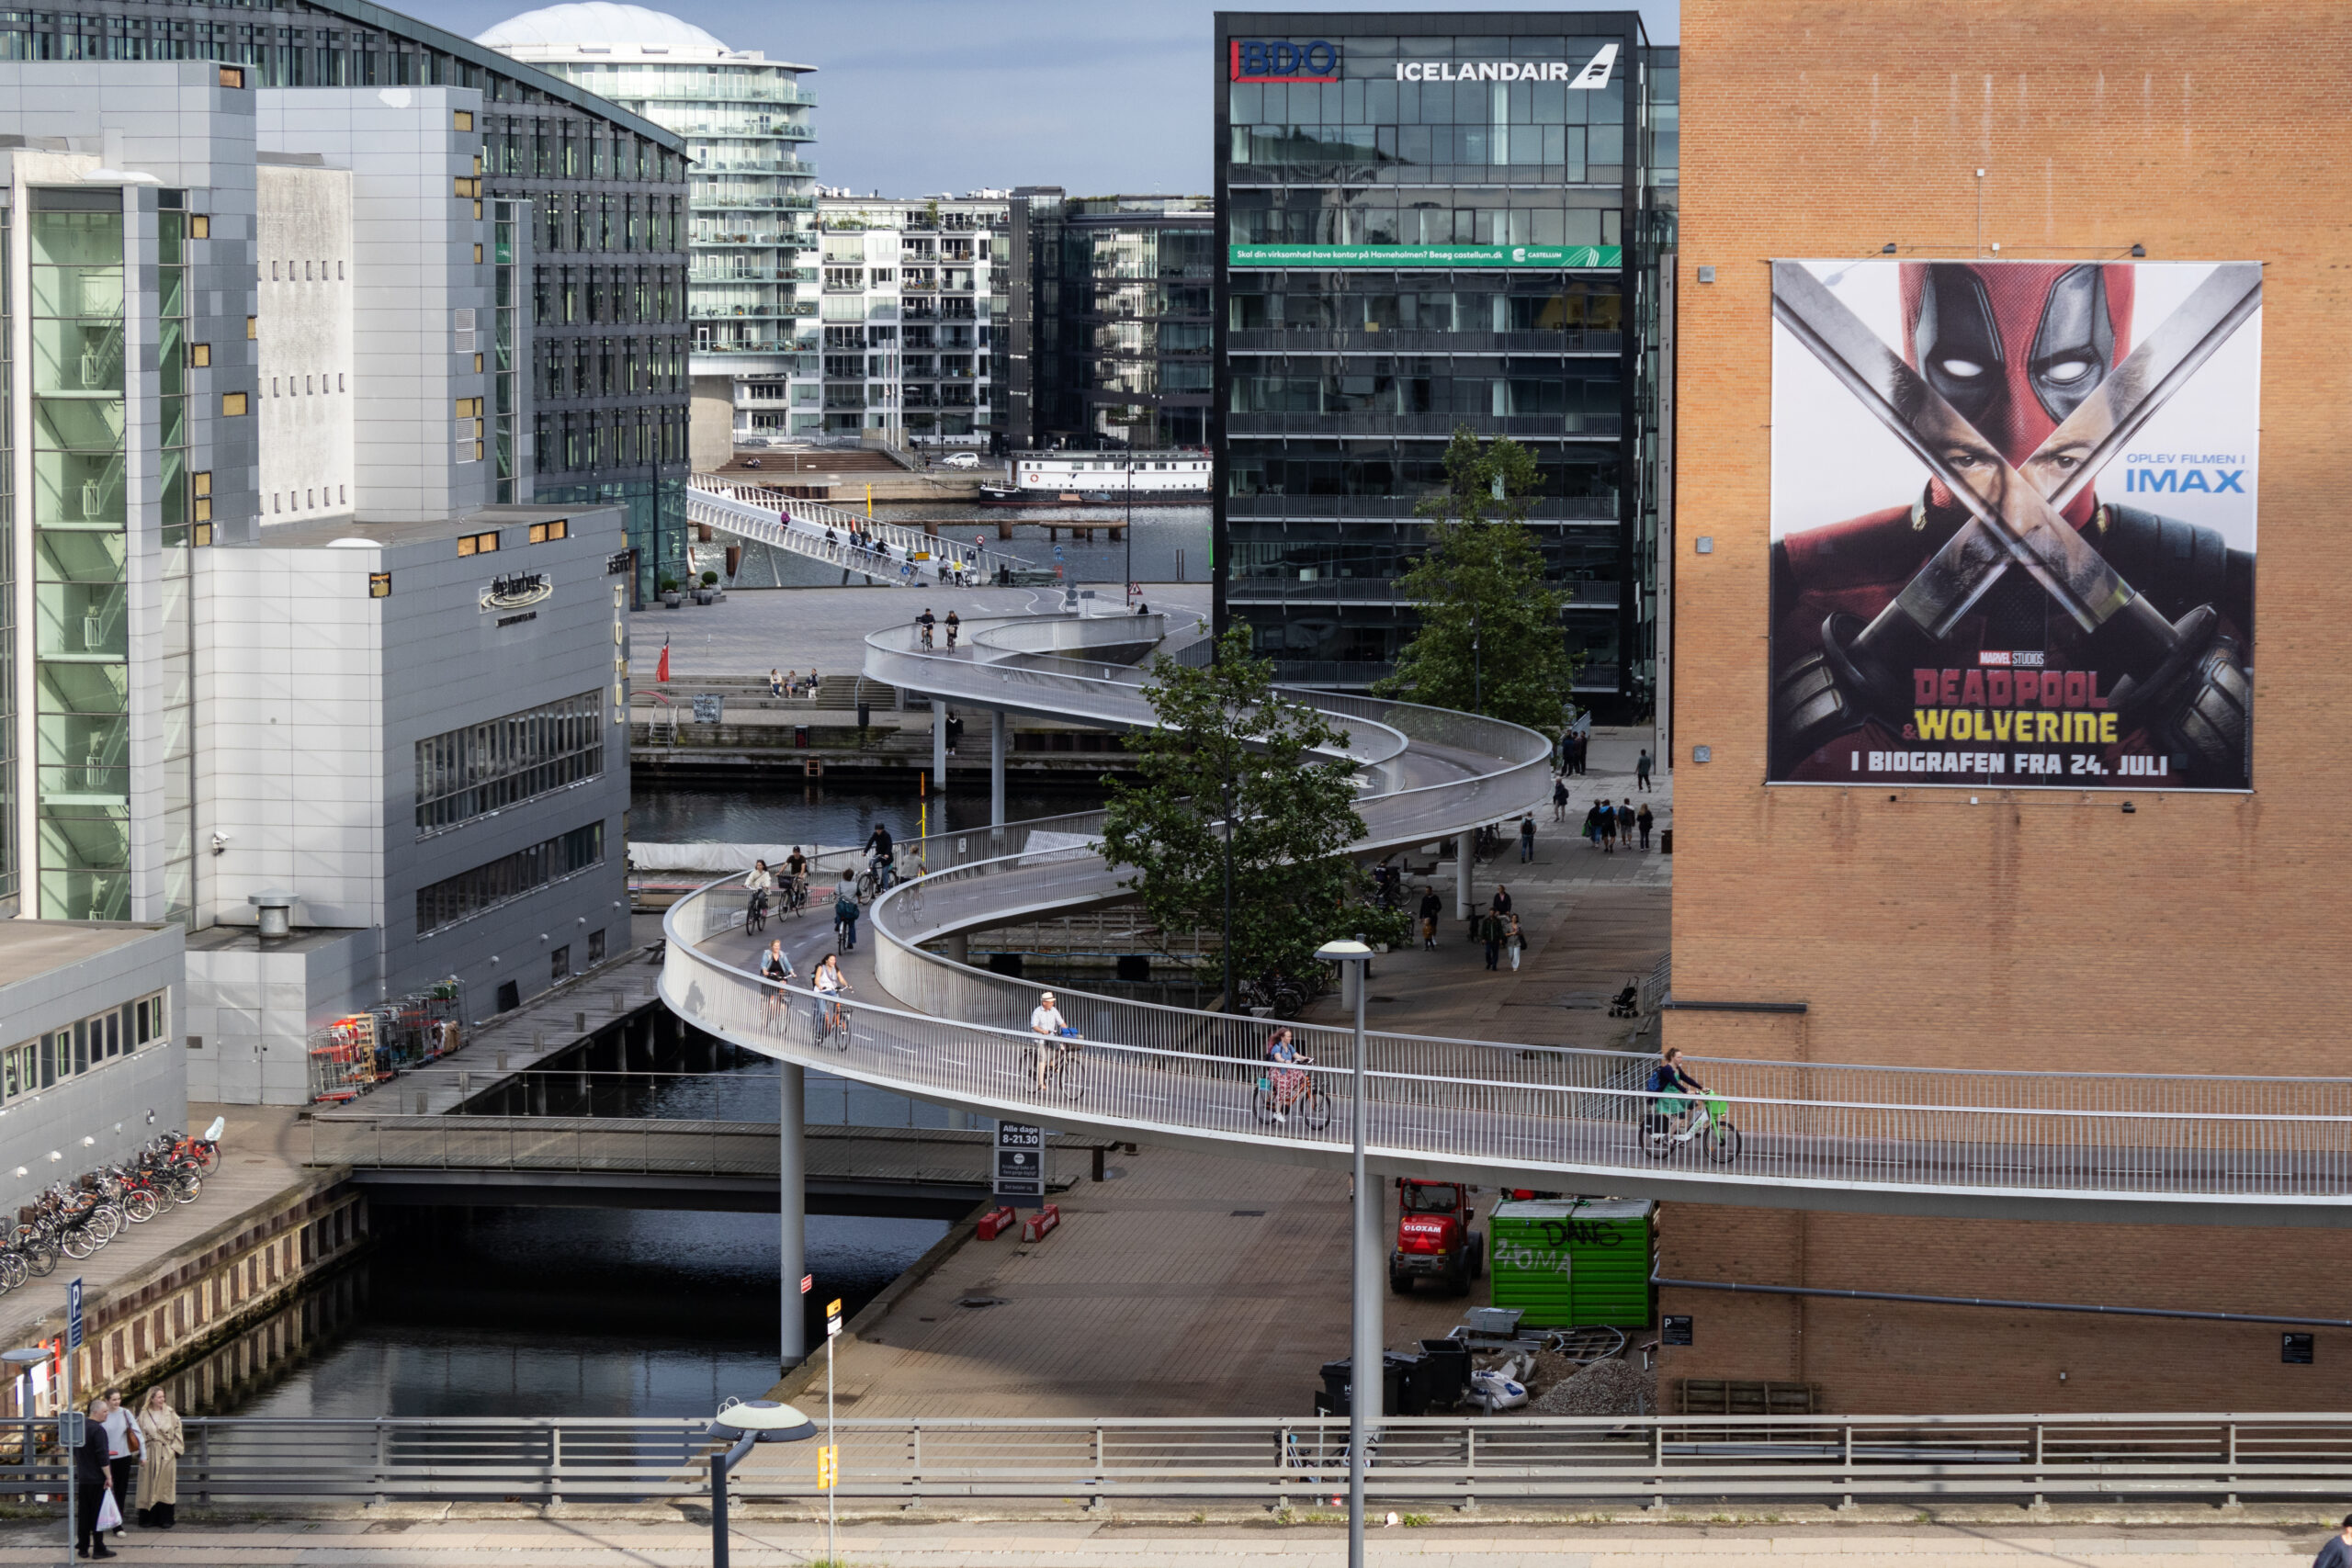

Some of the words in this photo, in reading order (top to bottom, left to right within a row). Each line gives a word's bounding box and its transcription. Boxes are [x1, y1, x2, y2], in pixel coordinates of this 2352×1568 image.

[1244, 40, 1337, 74] BDO
[1396, 62, 1568, 82] ICELANDAIR
[1238, 250, 1253, 258] Skal
[1255, 250, 1267, 258] din
[1268, 250, 1312, 258] virksomhed
[1313, 250, 1331, 258] have
[1333, 250, 1357, 258] kontor
[1359, 250, 1369, 260] på
[1371, 250, 1429, 259] Havneholmen?
[1430, 251, 1453, 261] Besøg
[1454, 250, 1503, 259] castellum.dk
[2126, 454, 2177, 464] OPLEV
[2180, 454, 2236, 465] FILMEN
[2241, 455, 2246, 464] I
[2126, 468, 2246, 493] IMAX
[1980, 651, 2011, 665] MARVEL
[2012, 651, 2044, 666] STUDIOS
[1914, 669, 2108, 708] DEADPOOL
[1904, 724, 1917, 739] &
[1915, 709, 2118, 742] WOLVERINE
[1851, 750, 1860, 773] I
[1868, 751, 2005, 774] BIOGRAFEN
[2014, 753, 2063, 774] FRA
[2070, 754, 2109, 776] 24.
[2117, 755, 2168, 776] JULI
[1020, 1126, 1038, 1134] dage
[1002, 1134, 1038, 1145] 8-21.30
[1410, 1224, 1442, 1234] LOXAM
[73, 1284, 80, 1318] P
[1664, 1318, 1672, 1328] P
[2284, 1336, 2292, 1346] P
